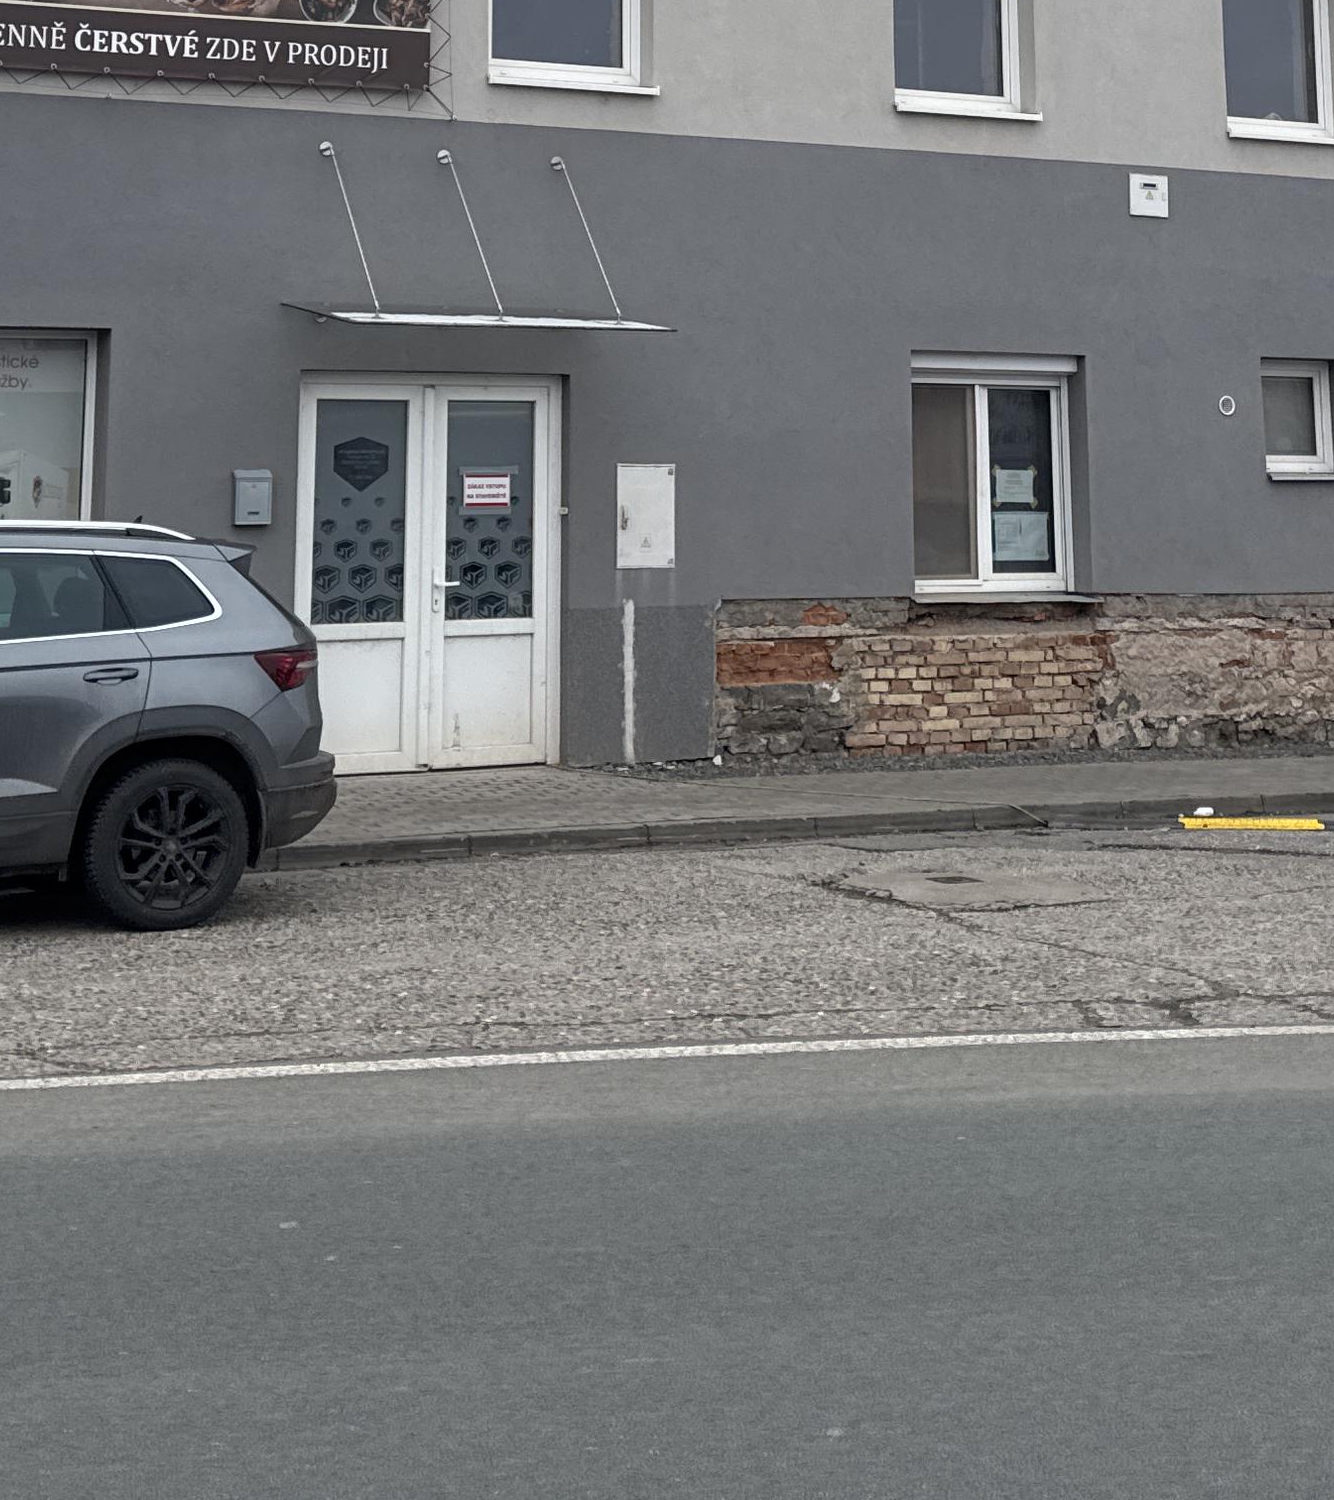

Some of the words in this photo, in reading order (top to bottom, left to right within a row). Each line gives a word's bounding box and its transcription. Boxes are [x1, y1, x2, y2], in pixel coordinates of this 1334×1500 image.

[74, 22, 199, 59] ČERSTVÉ
[206, 36, 255, 62] ZDE
[262, 40, 281, 64] V
[286, 42, 389, 73] PRODEJI
